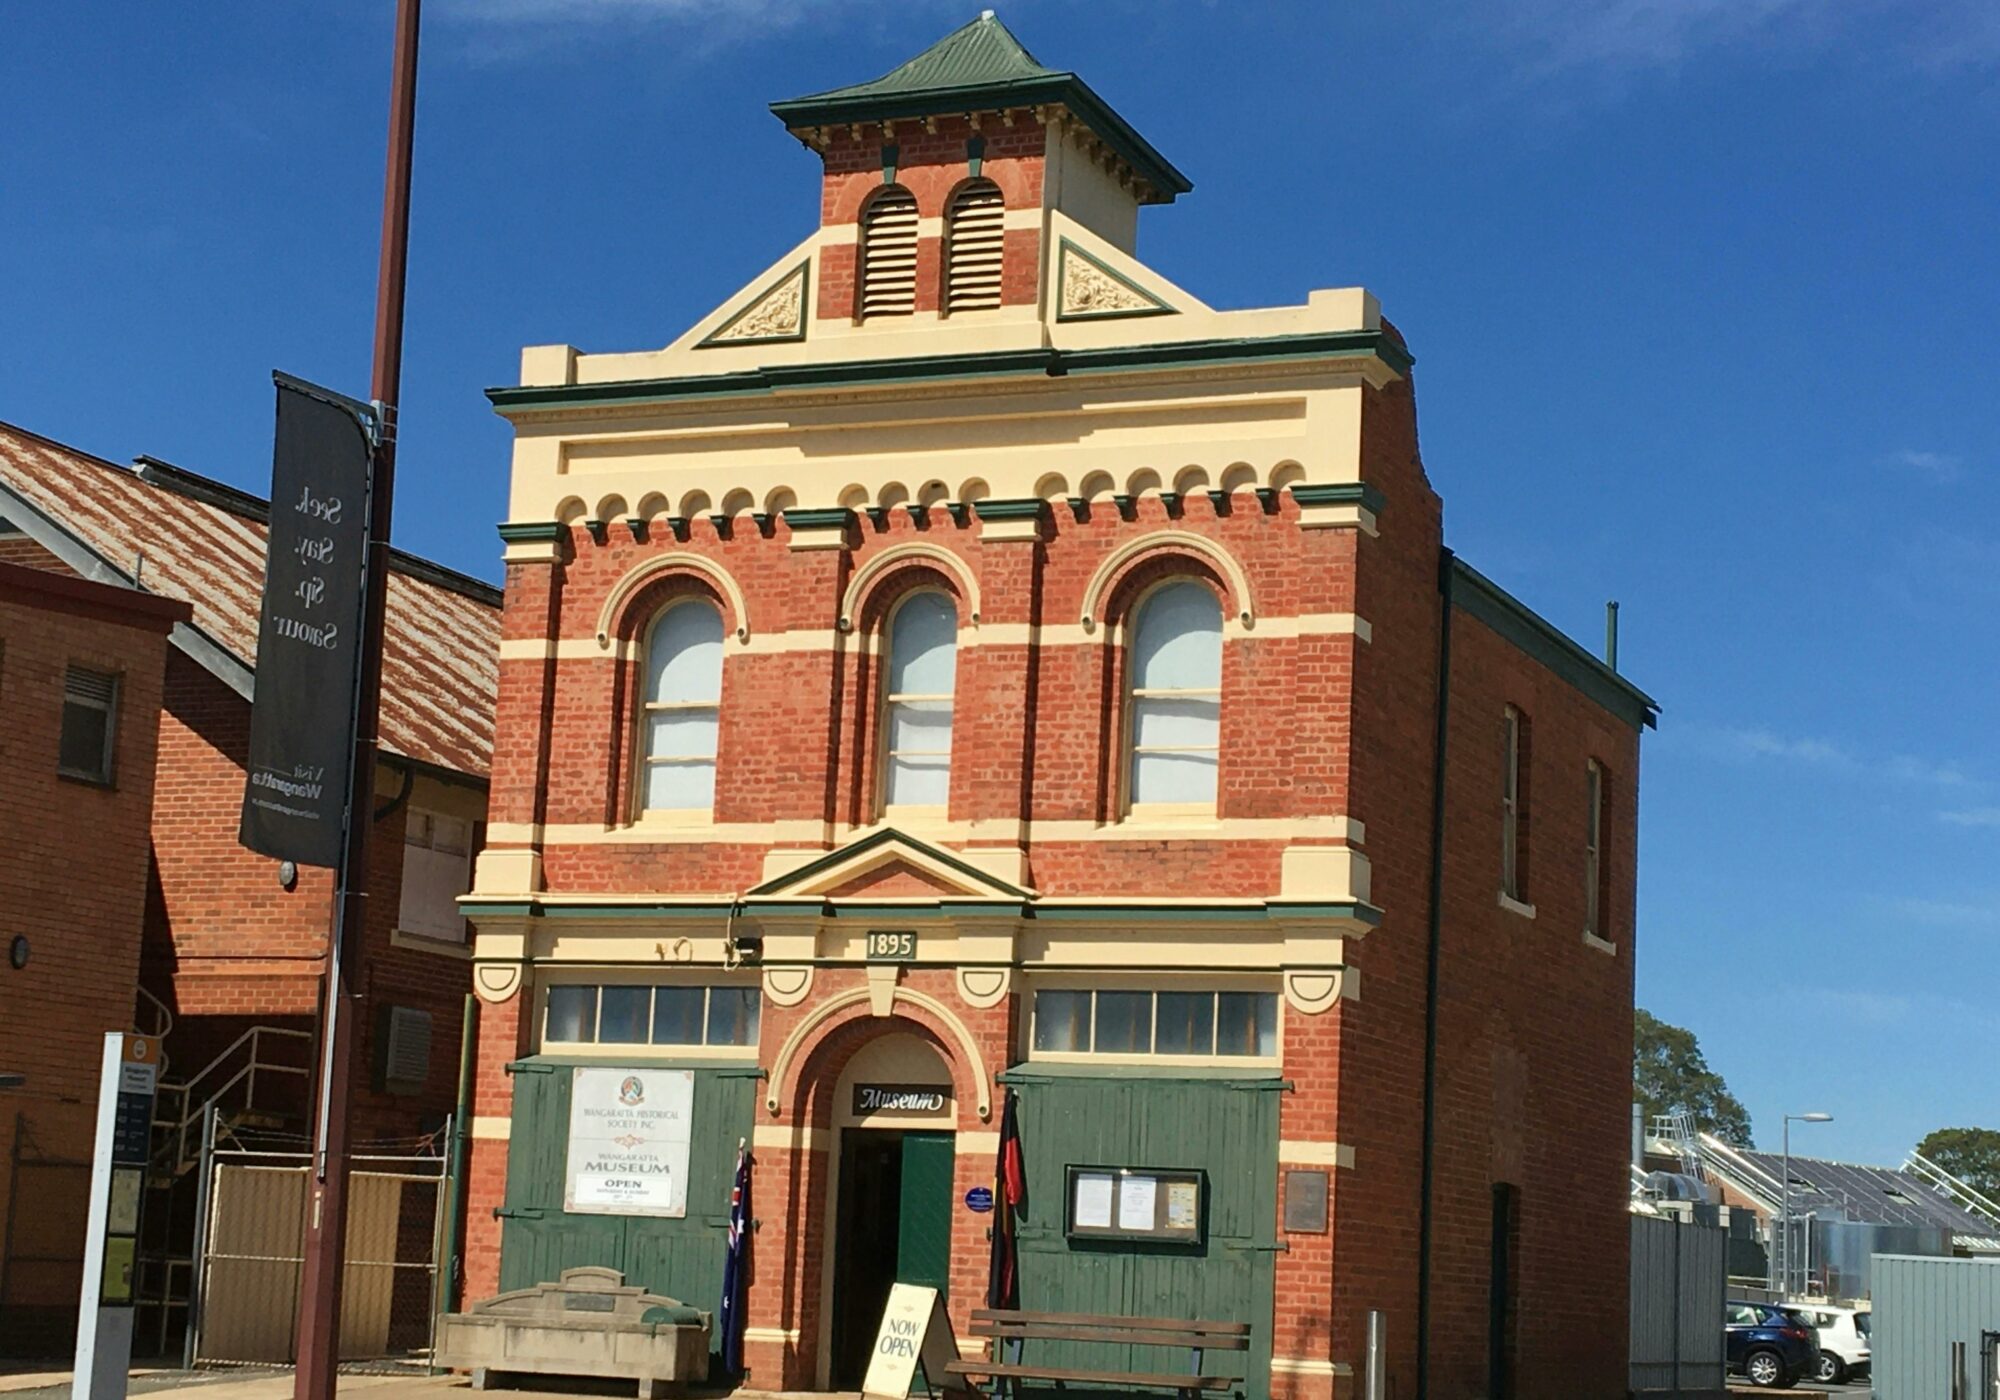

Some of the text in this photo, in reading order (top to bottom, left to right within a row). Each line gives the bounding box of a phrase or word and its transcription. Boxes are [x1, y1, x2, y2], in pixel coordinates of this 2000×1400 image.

[869, 933, 912, 956] 1895
[859, 1088, 944, 1111] Museum
[584, 1108, 679, 1120] WANGARATTA HISTORICAL
[607, 1119, 638, 1129] SOCIETY
[598, 1153, 659, 1162] WANGARATTA
[584, 1161, 670, 1174] MUSEUM
[604, 1179, 642, 1188] OPEN
[888, 1319, 921, 1336] NOW
[879, 1335, 918, 1359] OPEN
